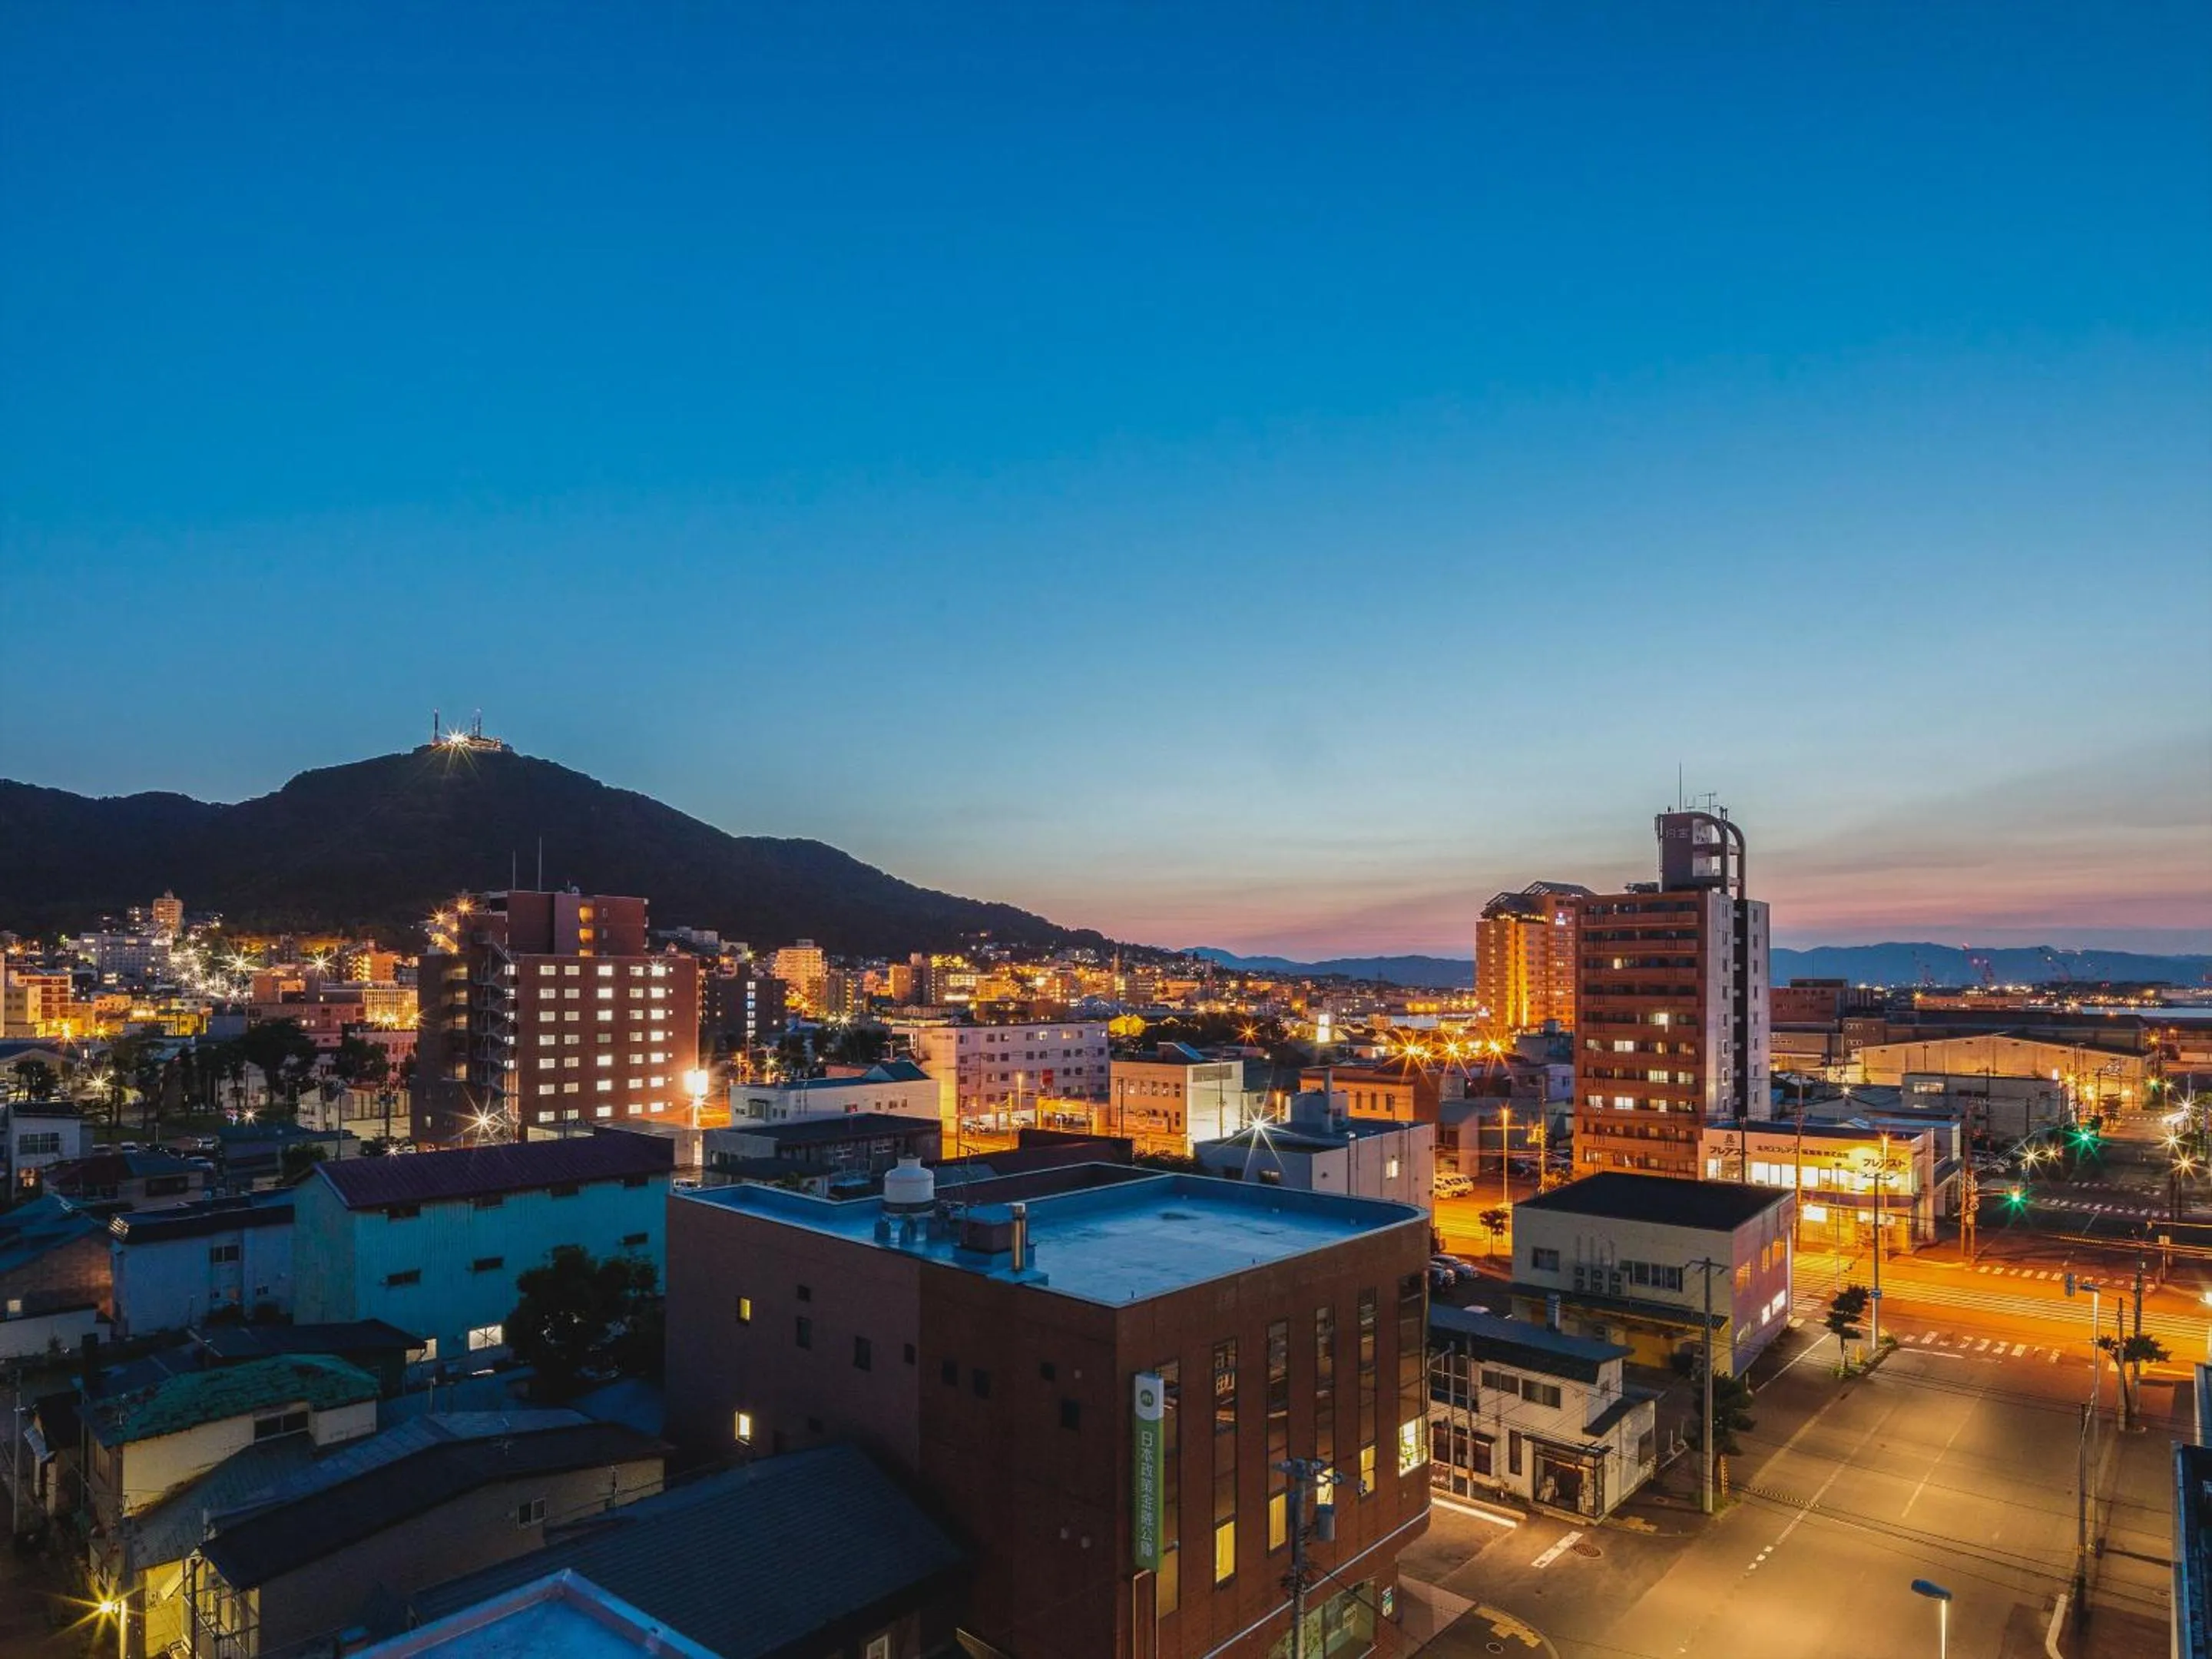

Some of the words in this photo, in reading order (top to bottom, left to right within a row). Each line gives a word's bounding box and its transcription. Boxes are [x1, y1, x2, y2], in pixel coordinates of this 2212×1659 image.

[1863, 1157, 1906, 1170] フレアスト
